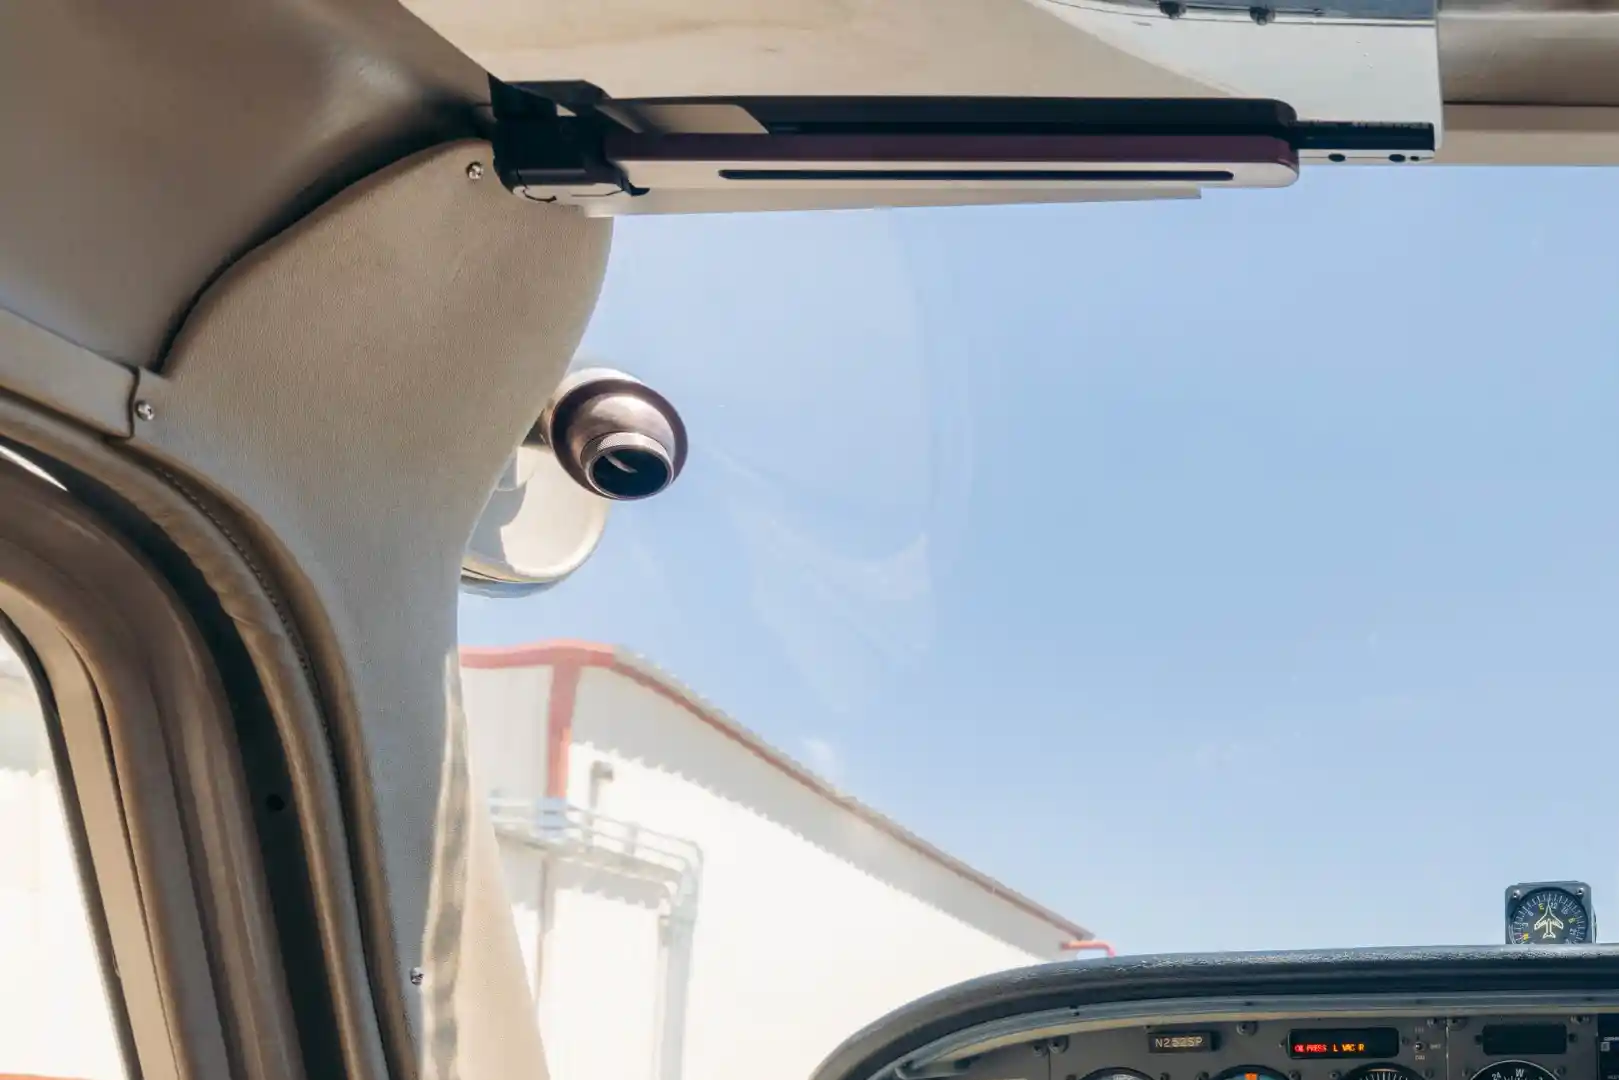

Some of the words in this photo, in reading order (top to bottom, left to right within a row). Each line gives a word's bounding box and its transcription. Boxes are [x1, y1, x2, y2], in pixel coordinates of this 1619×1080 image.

[1306, 1043, 1328, 1052] PRESS
[1333, 1043, 1339, 1052] L
[1358, 1043, 1365, 1051] R
[1492, 1072, 1501, 1080] 24
[1515, 1069, 1524, 1077] W
